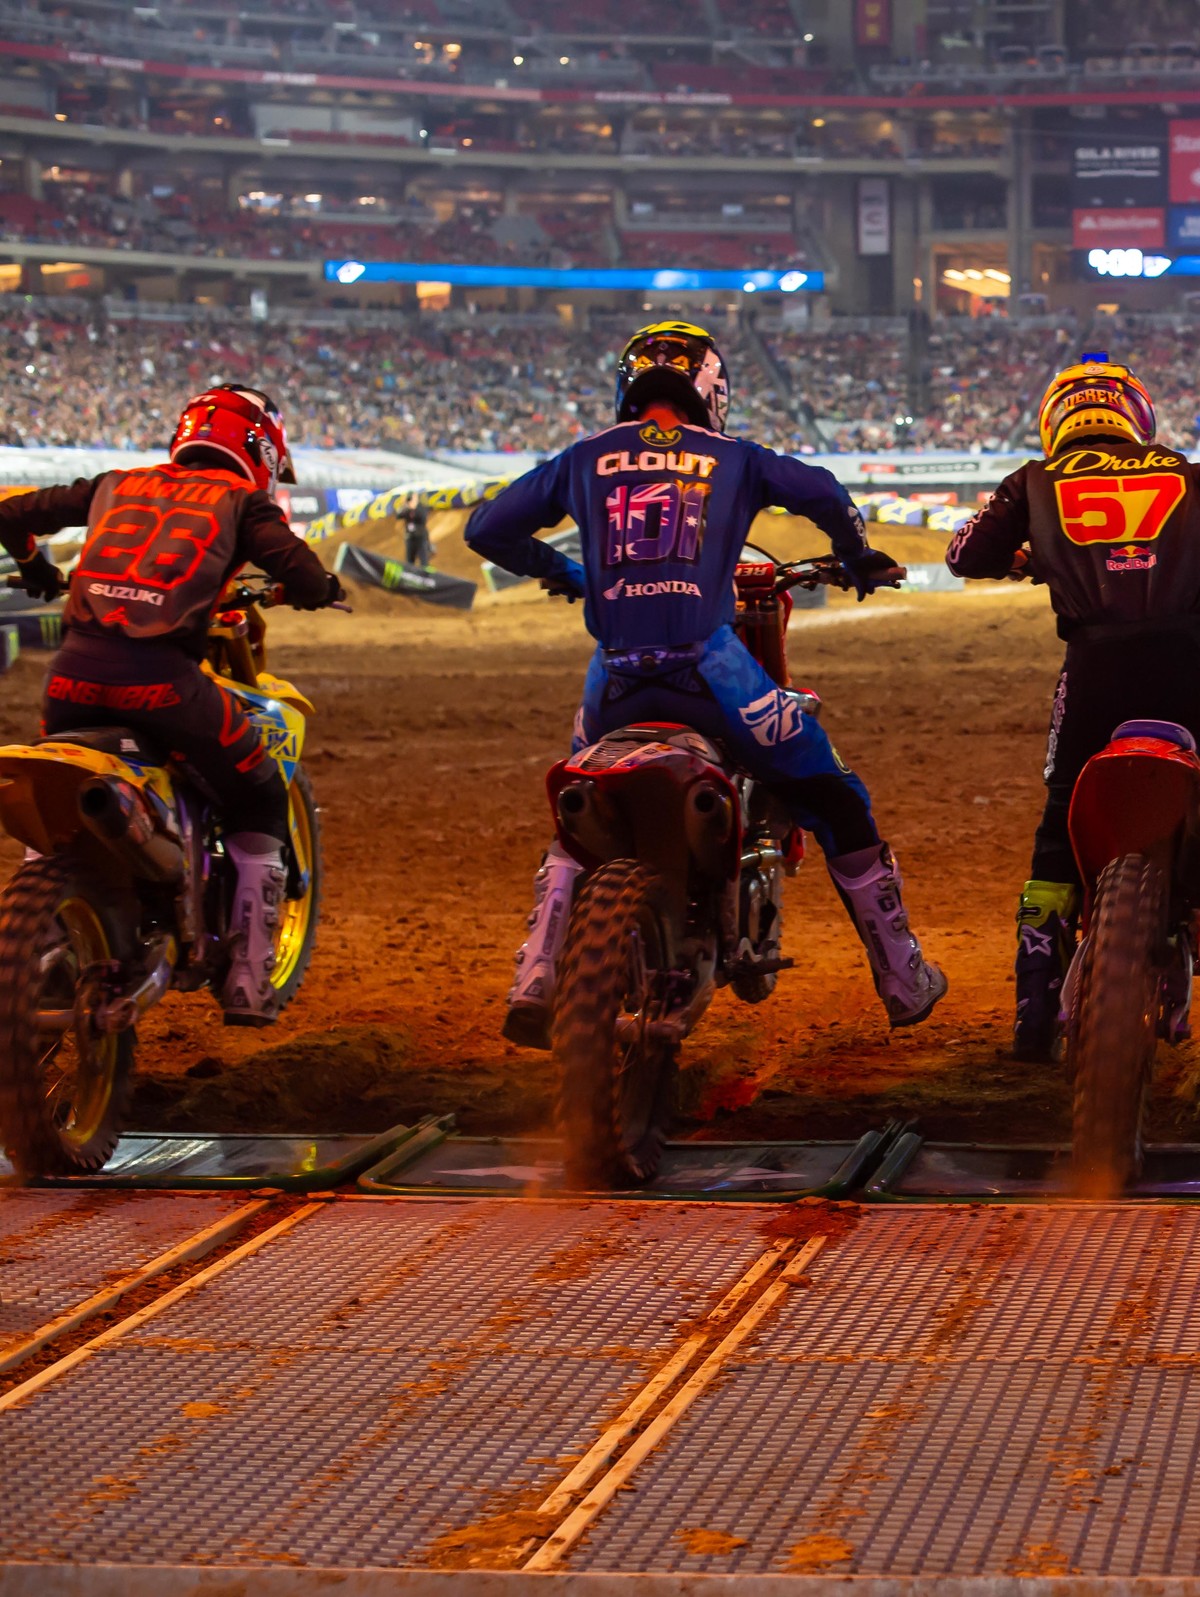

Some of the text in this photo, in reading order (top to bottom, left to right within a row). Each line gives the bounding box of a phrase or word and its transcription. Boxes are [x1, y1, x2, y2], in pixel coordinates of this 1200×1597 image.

[1062, 388, 1121, 411] DEREK
[596, 451, 718, 478] CLOUT
[1045, 451, 1181, 474] Drake
[112, 475, 229, 505] MARTIN
[1054, 473, 1187, 546] 57
[606, 483, 706, 565] 101
[76, 503, 221, 591] 26
[1106, 558, 1132, 570] Red
[88, 583, 166, 606] SUZUKI
[625, 580, 702, 598] HONDA
